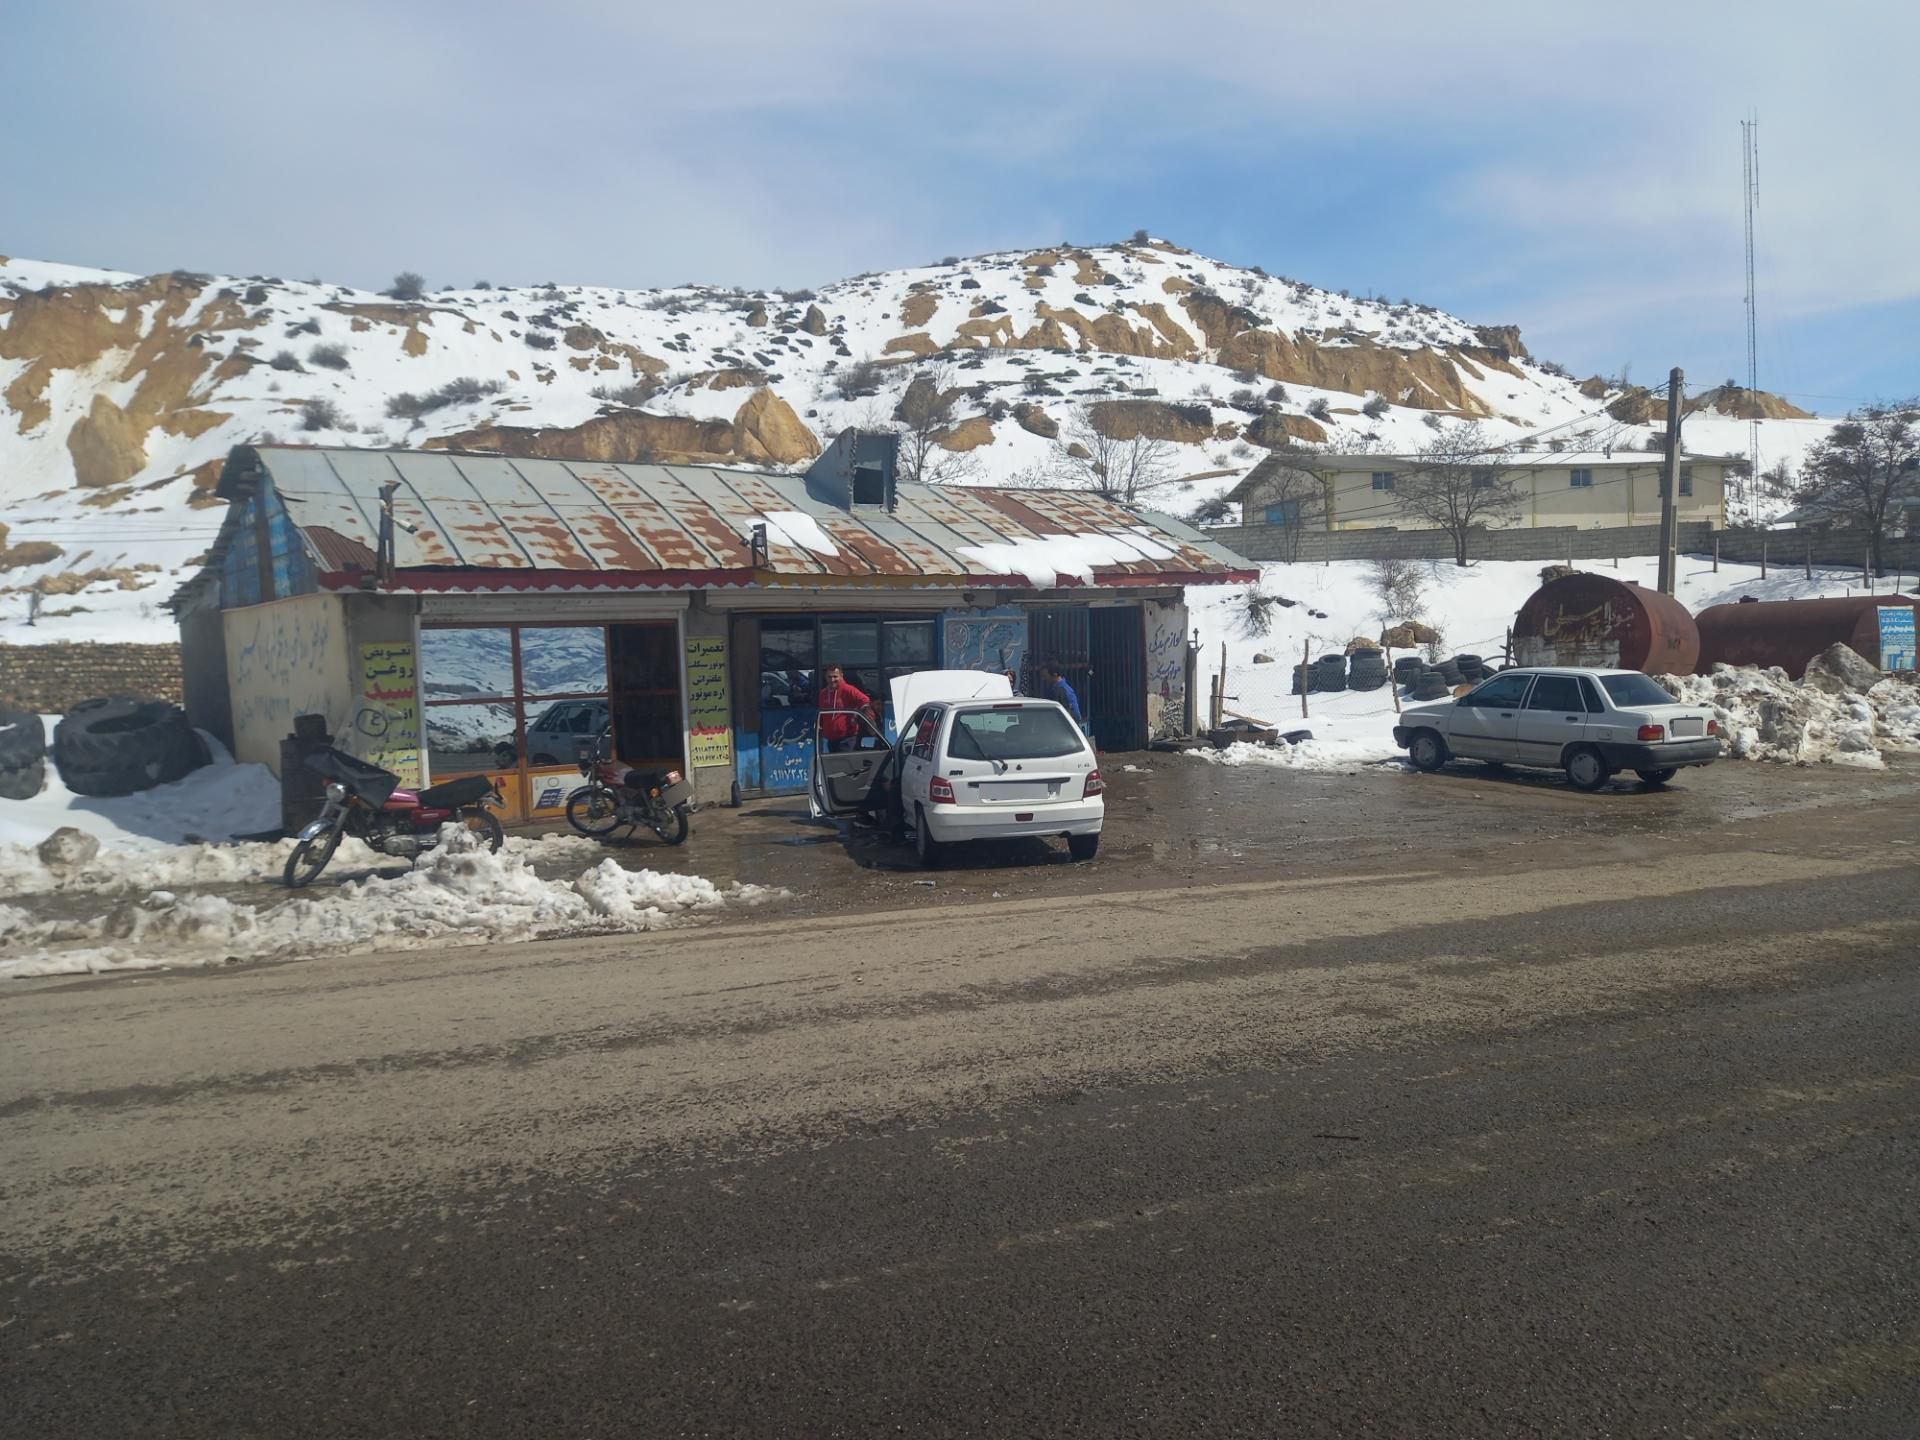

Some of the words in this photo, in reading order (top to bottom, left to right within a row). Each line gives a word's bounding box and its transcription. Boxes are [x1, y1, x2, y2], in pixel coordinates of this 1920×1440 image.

[687, 642, 724, 656] تعمیرات
[1163, 629, 1184, 653] لوازم
[364, 645, 411, 660] تعویض
[366, 662, 414, 679] روغن
[767, 717, 814, 751] پنچرگیری
